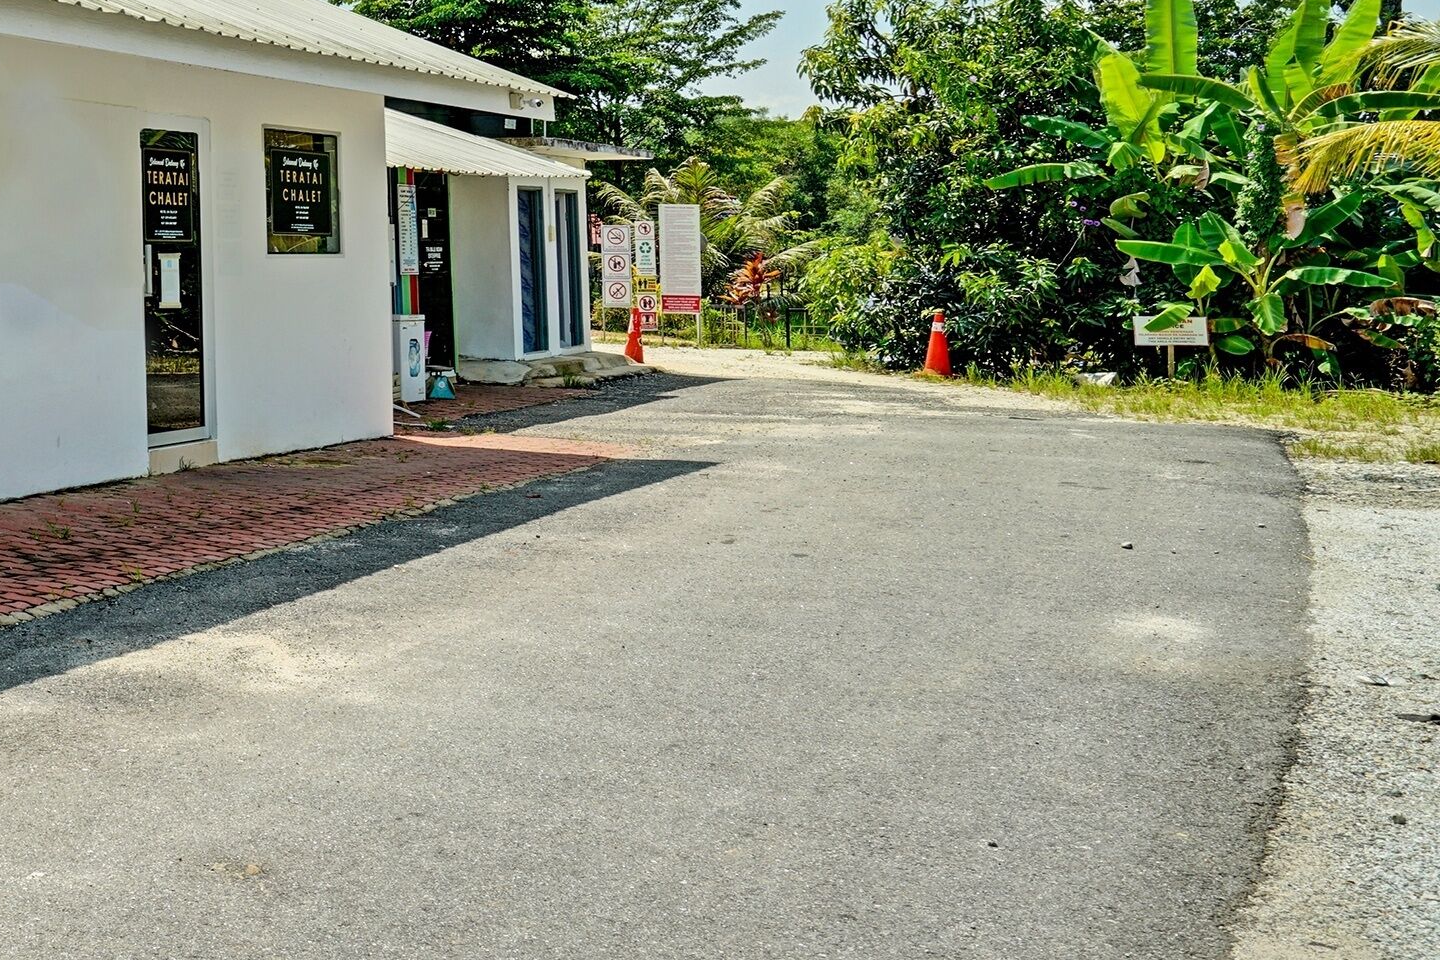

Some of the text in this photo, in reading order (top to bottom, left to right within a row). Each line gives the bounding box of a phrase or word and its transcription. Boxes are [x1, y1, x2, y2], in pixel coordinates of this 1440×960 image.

[147, 171, 188, 186] TERATAI
[280, 170, 322, 185] TERATAI
[149, 191, 188, 206] CHALET
[283, 188, 321, 202] CHALET
